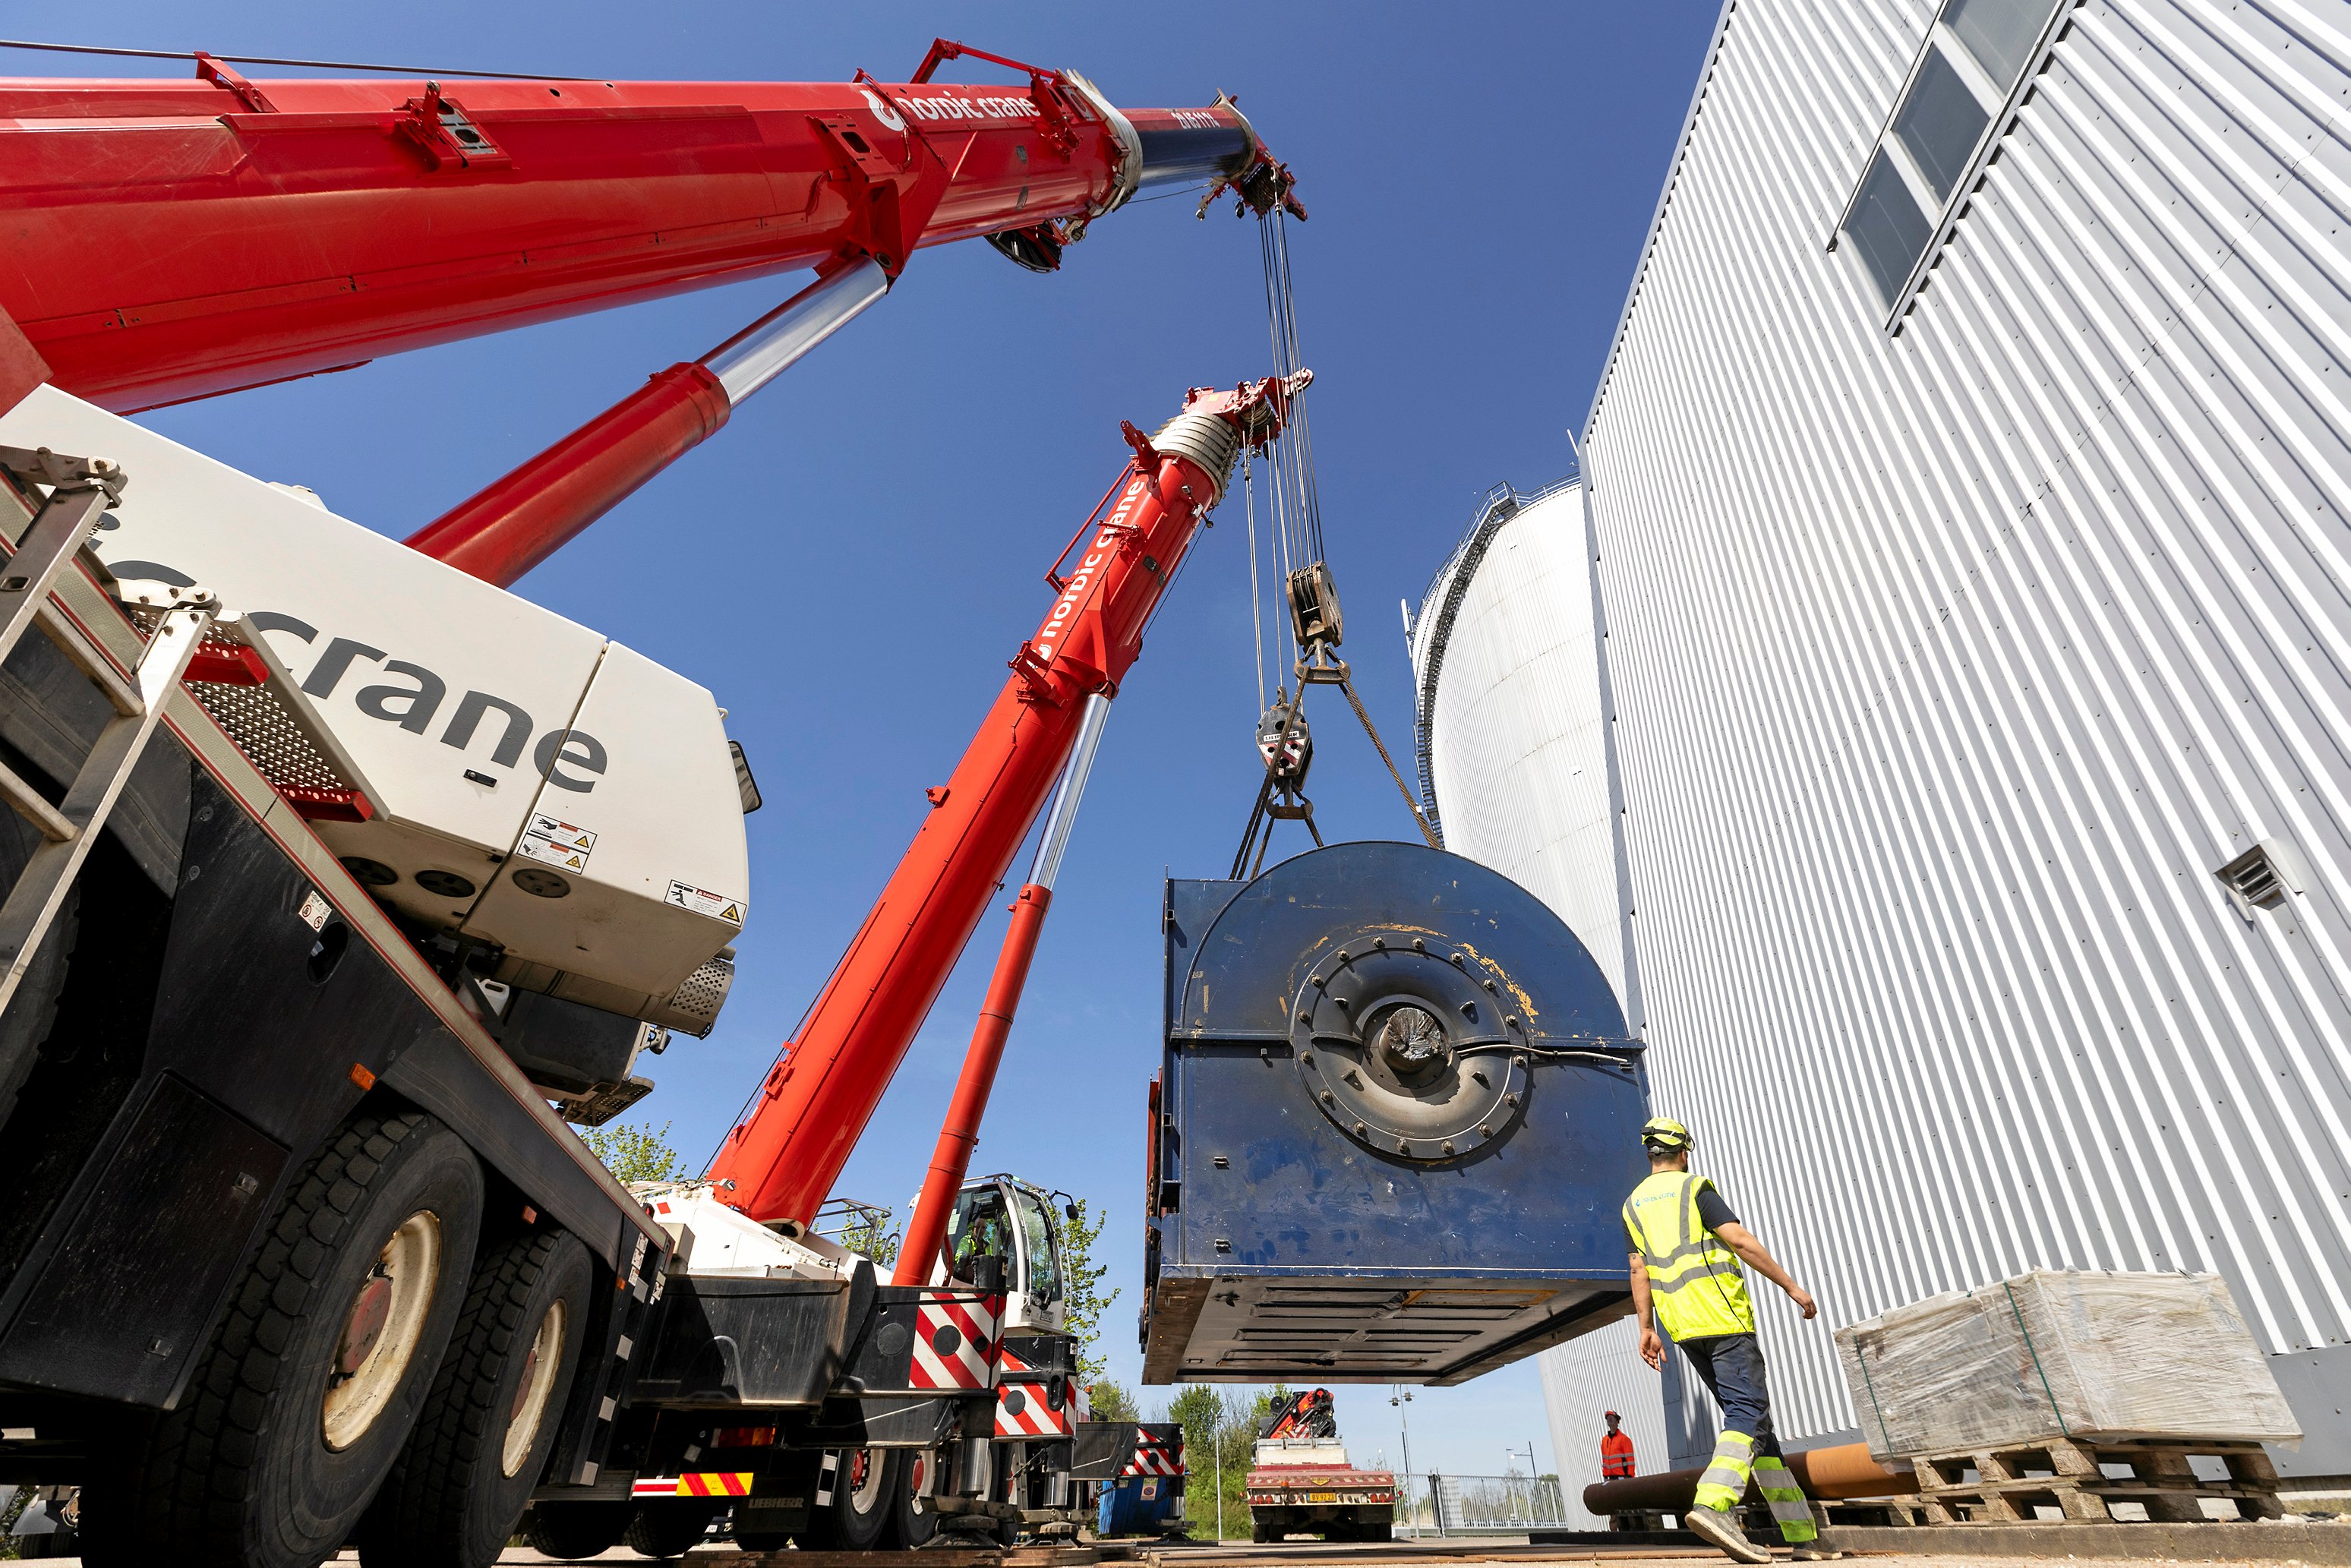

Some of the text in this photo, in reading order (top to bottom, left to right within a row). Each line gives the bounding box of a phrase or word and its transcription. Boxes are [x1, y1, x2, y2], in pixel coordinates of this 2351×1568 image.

[895, 90, 1041, 120] nordic crane
[1042, 480, 1144, 639] nordic crane
[702, 892, 722, 901] DANGER
[748, 1497, 804, 1509] LIEBHERR
